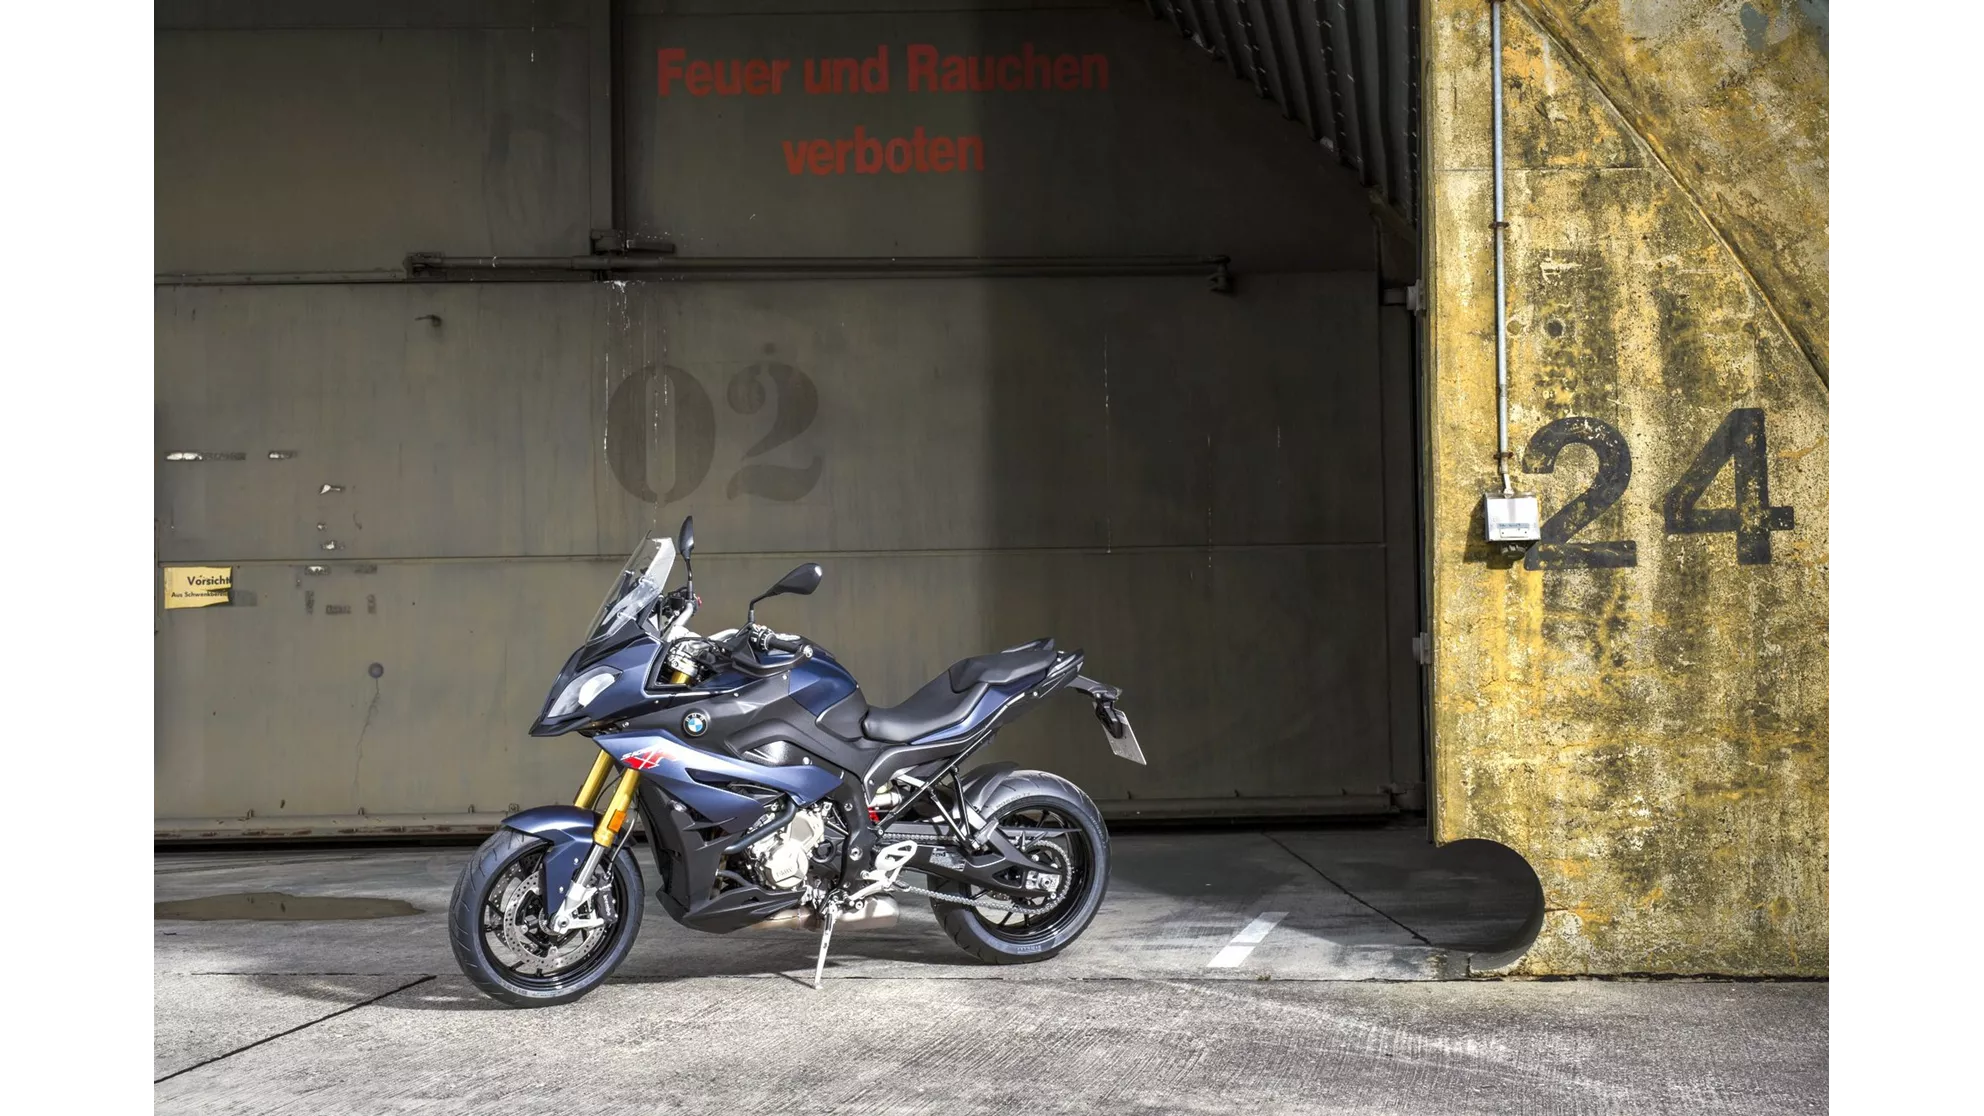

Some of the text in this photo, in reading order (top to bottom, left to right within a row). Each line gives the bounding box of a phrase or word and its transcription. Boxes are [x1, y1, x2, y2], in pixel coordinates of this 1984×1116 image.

[657, 42, 1110, 98] Feuer und Rauchen
[782, 126, 985, 176] verboten
[607, 361, 825, 504] 02
[1521, 407, 1796, 571] 24
